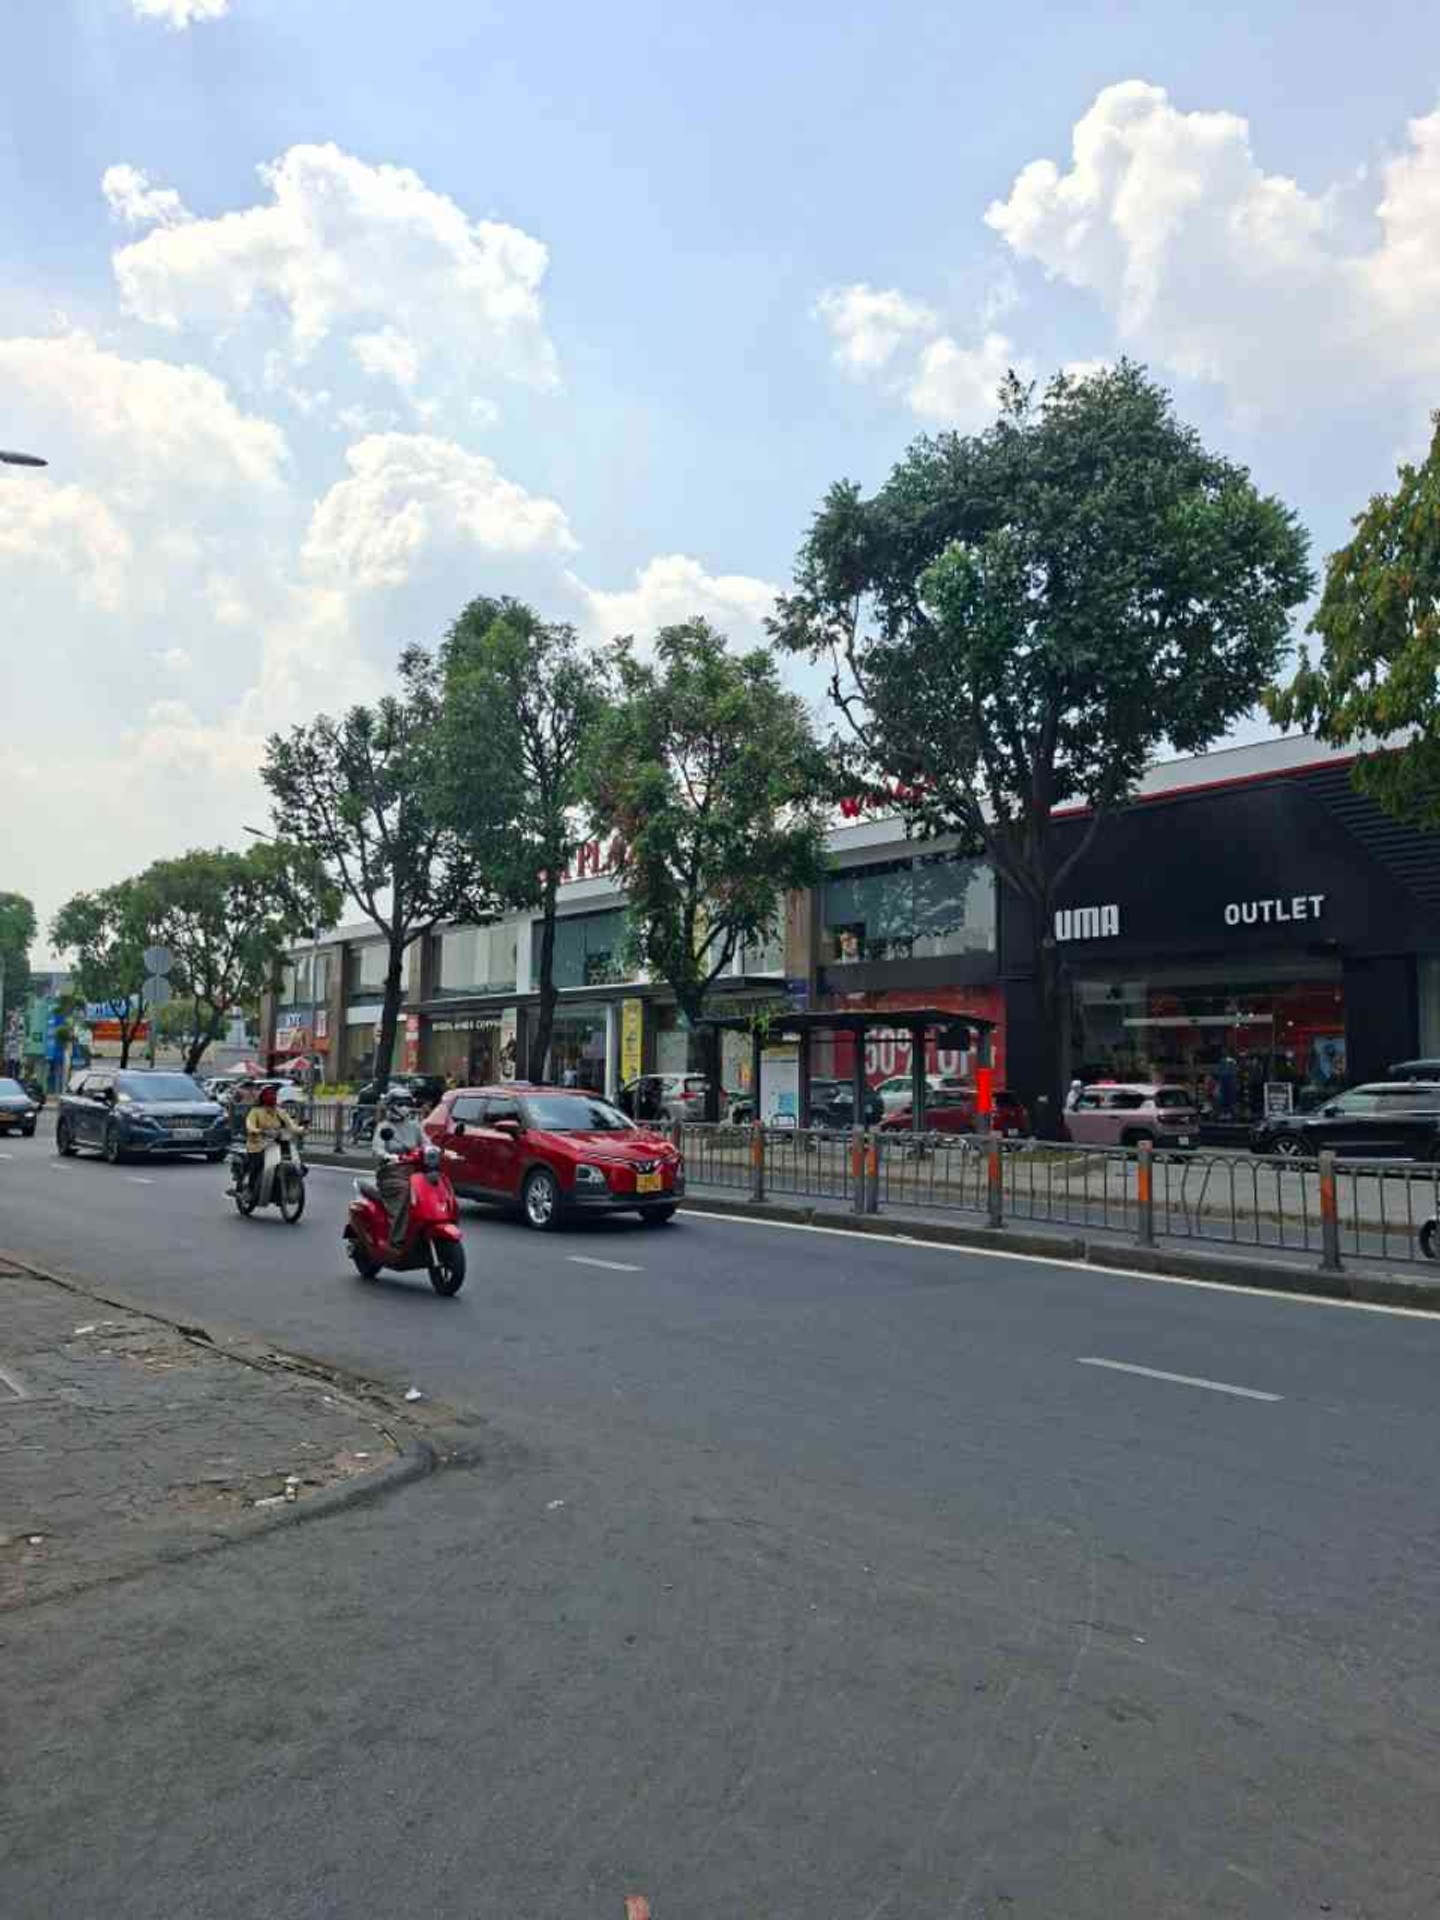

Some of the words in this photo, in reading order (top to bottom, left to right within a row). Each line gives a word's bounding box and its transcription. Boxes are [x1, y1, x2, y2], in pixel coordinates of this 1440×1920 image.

[1055, 904, 1119, 941] UMA
[1224, 895, 1325, 925] OUTLET
[937, 1026, 998, 1074] OF
